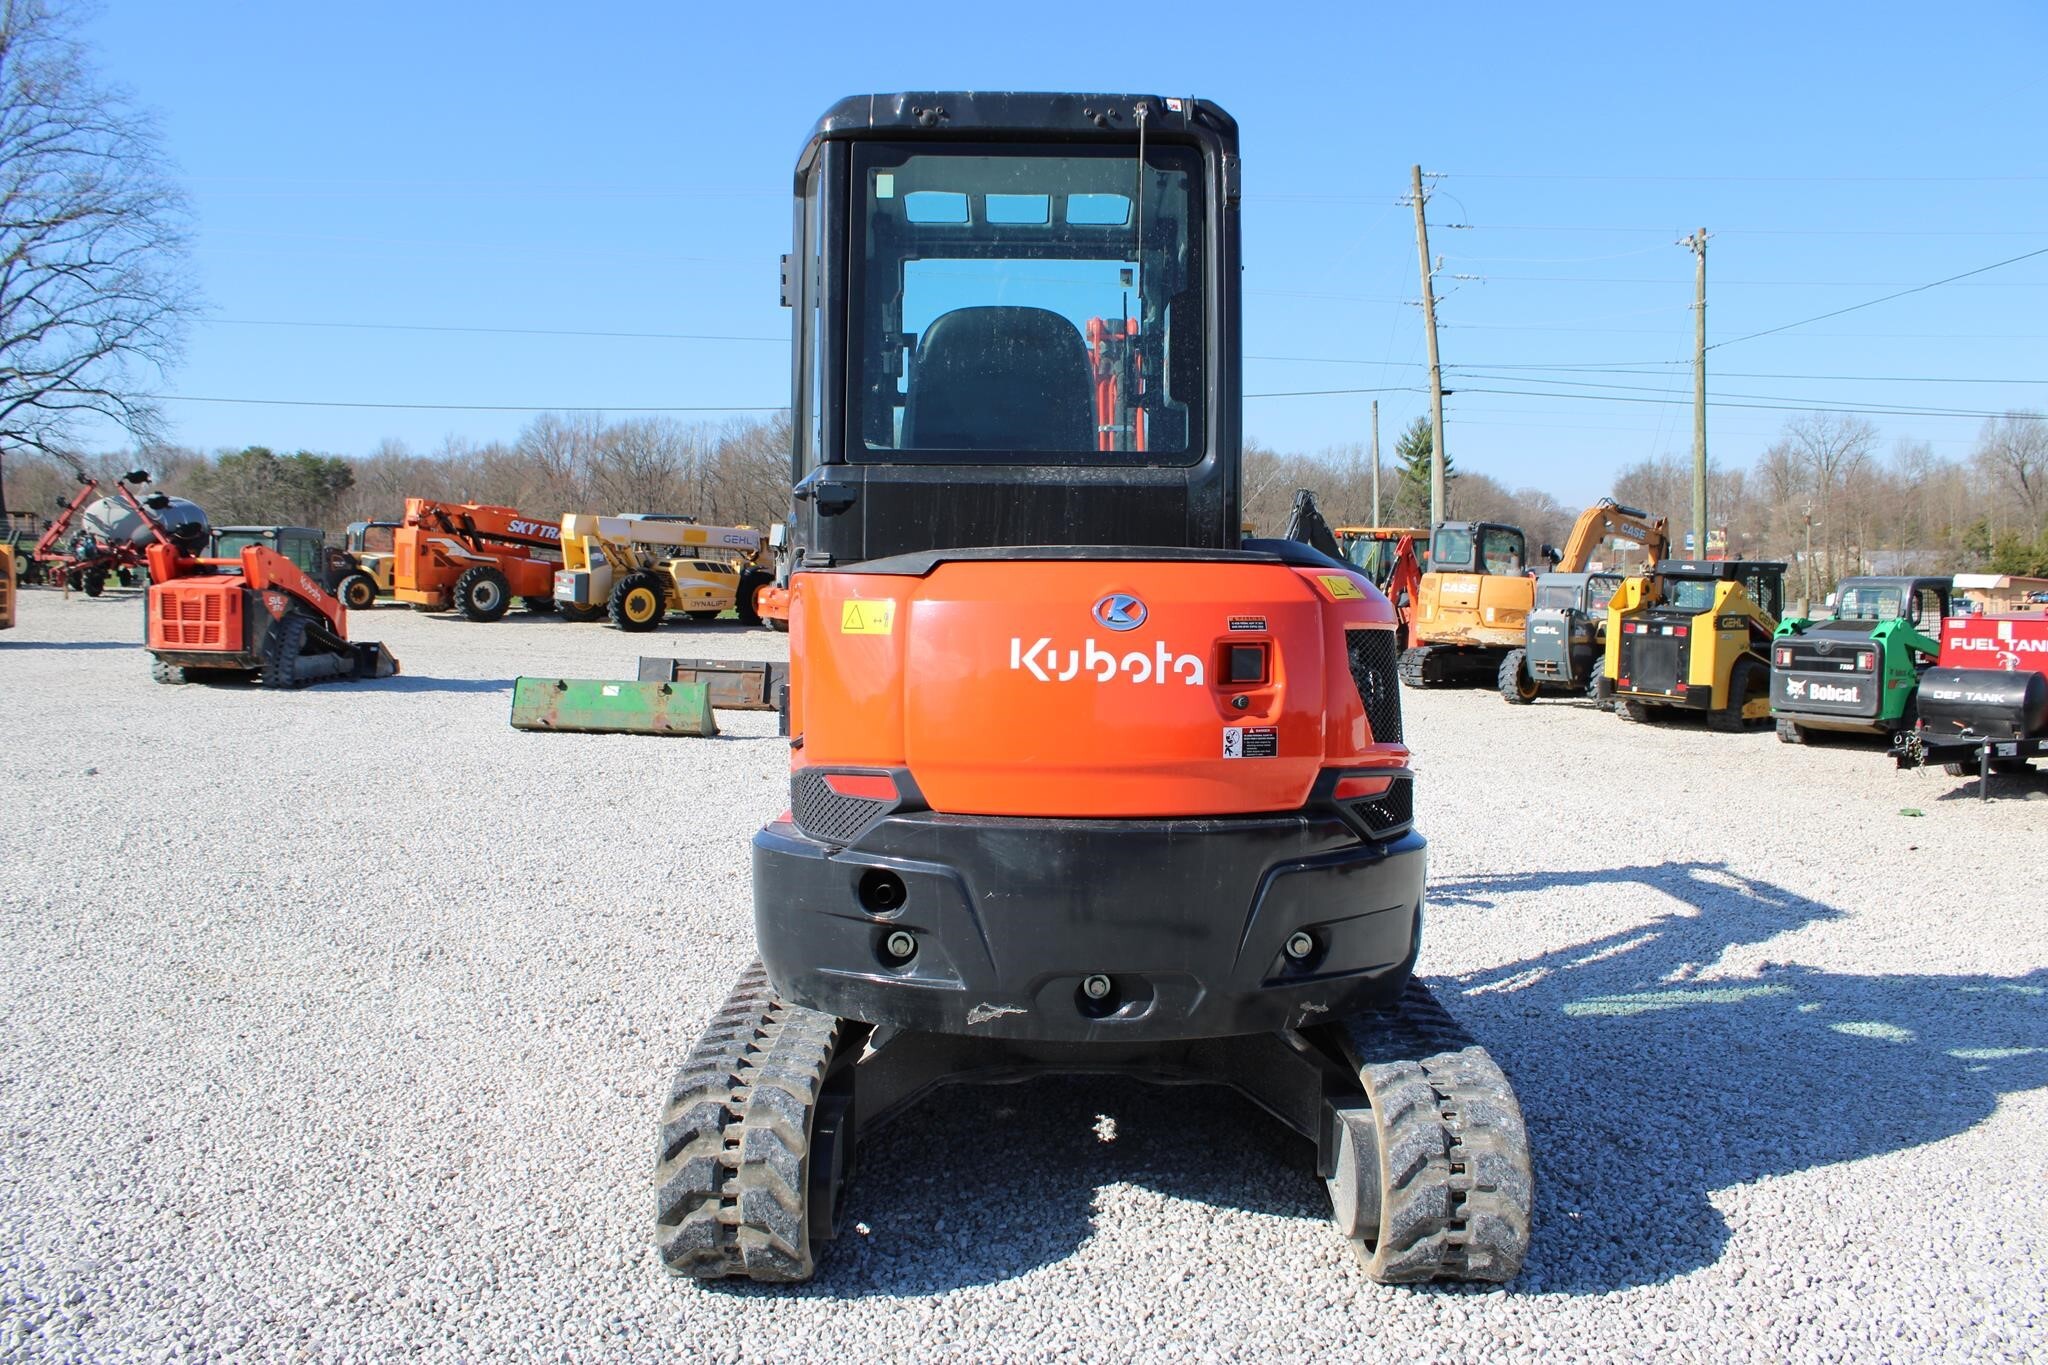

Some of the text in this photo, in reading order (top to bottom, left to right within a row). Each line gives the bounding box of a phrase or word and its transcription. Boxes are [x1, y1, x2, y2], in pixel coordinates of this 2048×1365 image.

[507, 520, 540, 534] SKY
[1621, 523, 1647, 540] CASE
[723, 534, 753, 545] GEHL
[1442, 582, 1478, 594] CASE
[690, 599, 728, 608] DYNALIFT
[1721, 616, 1744, 628] GEHL
[1533, 626, 1560, 635] GEHL
[1950, 638, 2048, 652] FUEL TAN
[1010, 637, 1205, 686] Kubota
[1933, 690, 2005, 703] DEF TANK
